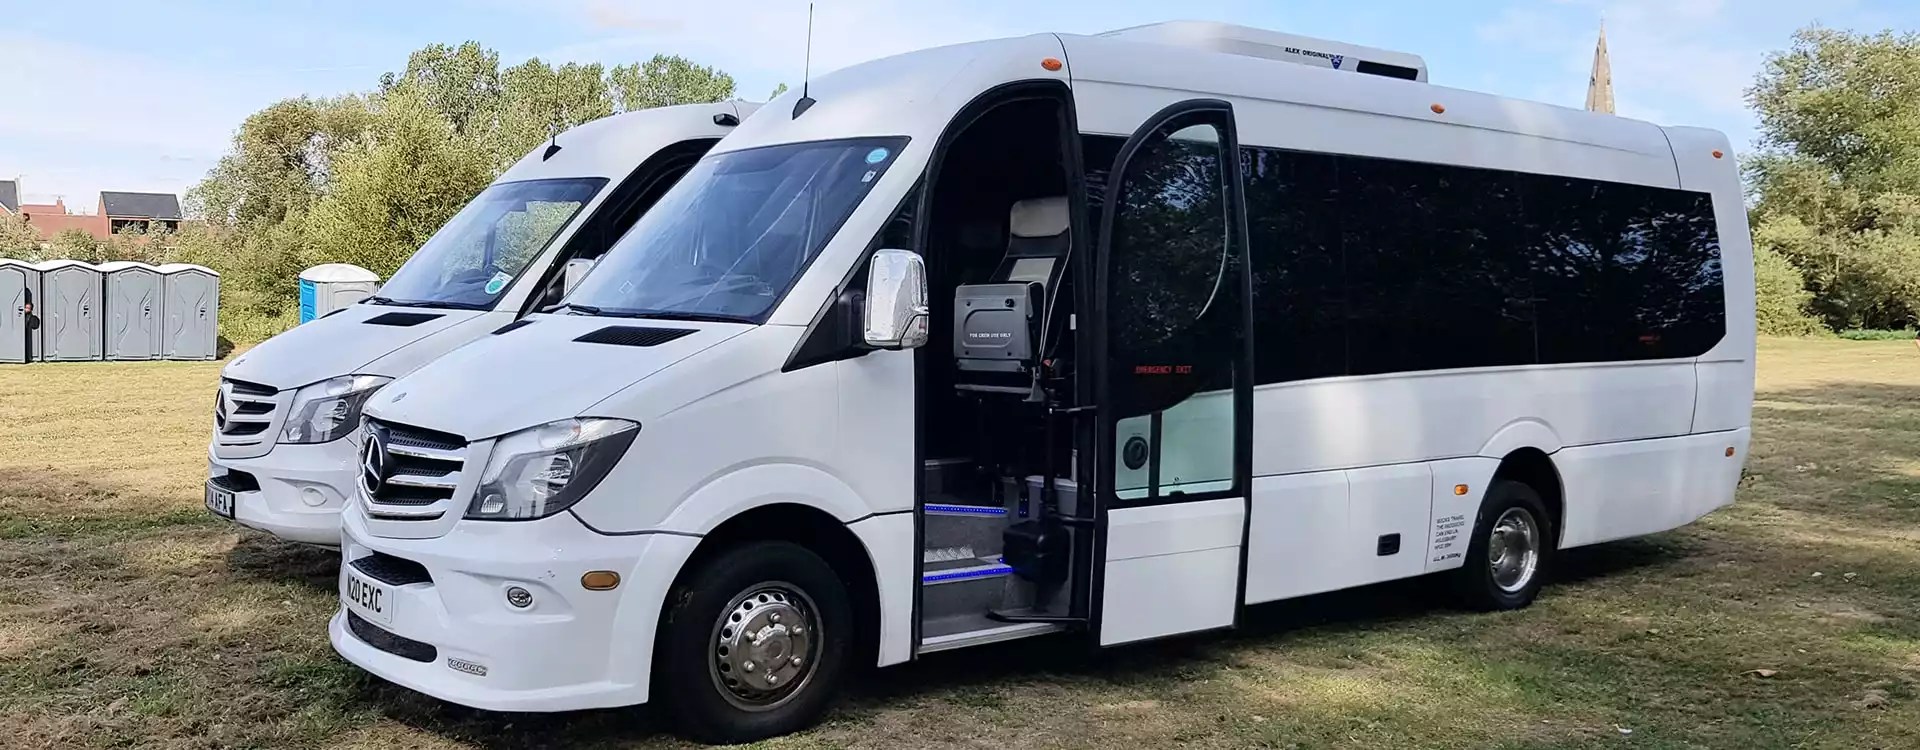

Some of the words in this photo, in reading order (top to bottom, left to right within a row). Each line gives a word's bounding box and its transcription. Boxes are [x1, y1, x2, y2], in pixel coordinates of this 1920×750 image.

[1302, 50, 1329, 59] ORIGINAL
[1176, 366, 1192, 374] EXIT
[215, 492, 228, 513] AFA
[346, 572, 360, 603] N20
[362, 582, 382, 613] EXC
